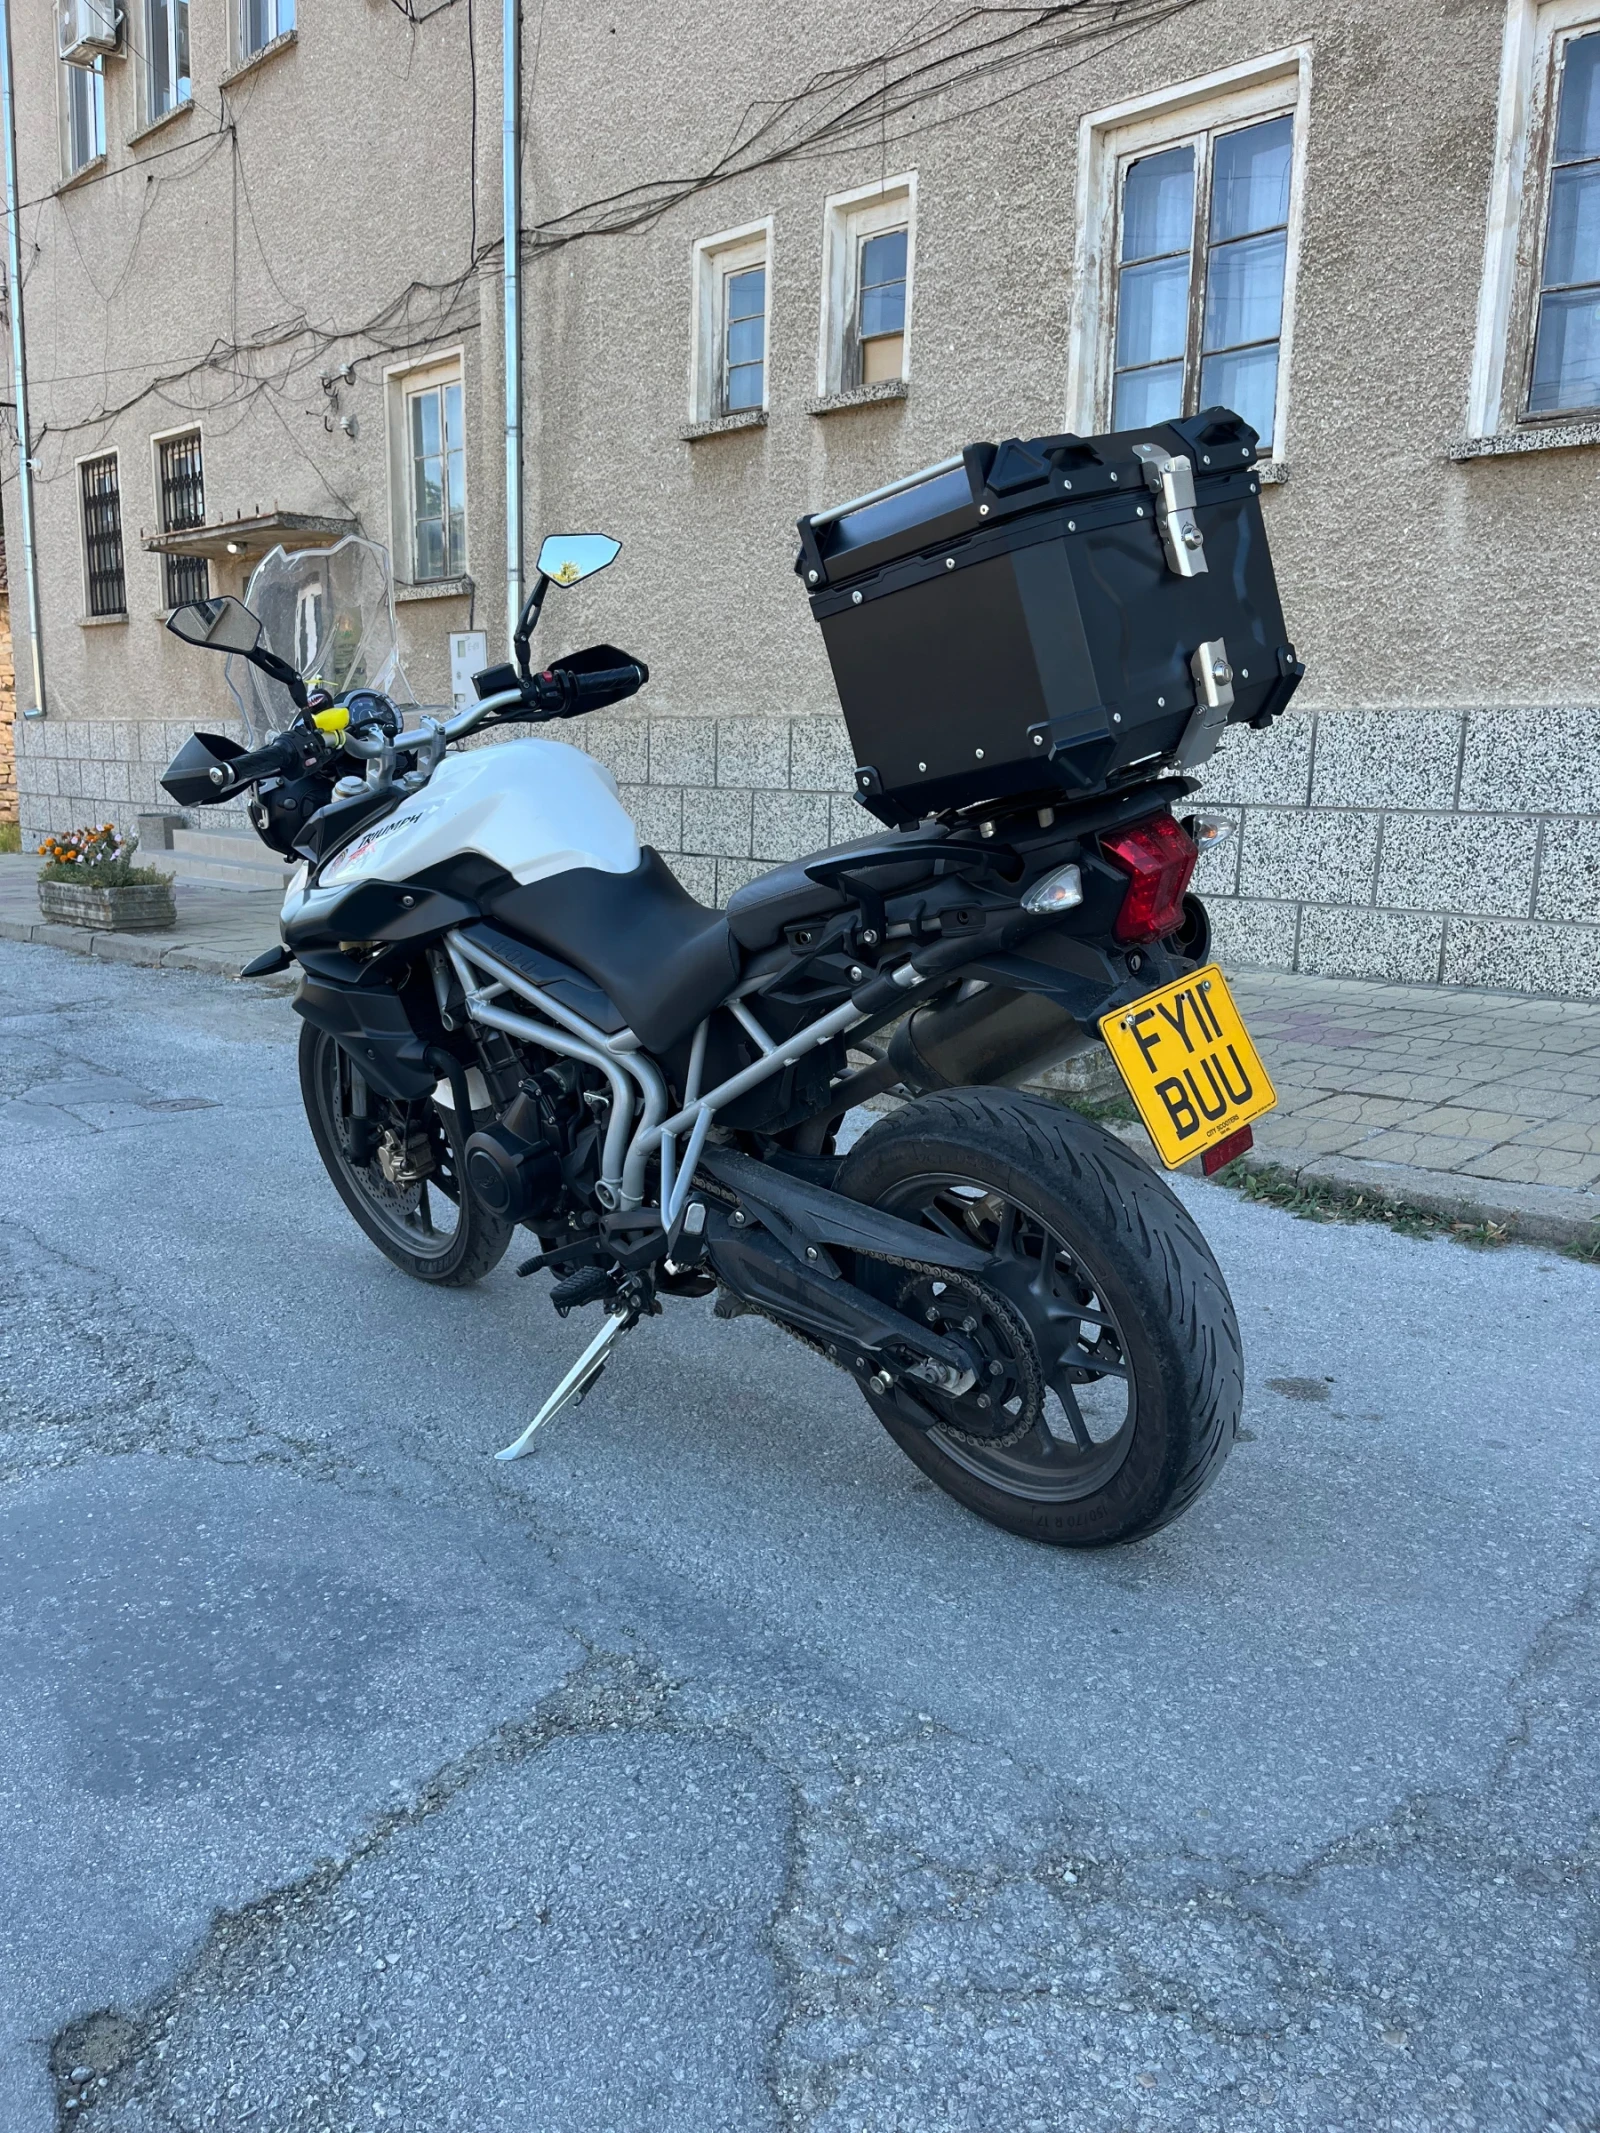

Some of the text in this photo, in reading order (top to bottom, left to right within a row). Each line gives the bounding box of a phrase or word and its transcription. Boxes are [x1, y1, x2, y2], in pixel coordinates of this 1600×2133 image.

[358, 812, 423, 849] TRIUMPH
[1128, 983, 1223, 1074] FY11
[1154, 1044, 1253, 1141] BUU
[1206, 1127, 1217, 1138] CITY
[1217, 1114, 1240, 1132] SCOOTERS
[1036, 1516, 1049, 1528] 17
